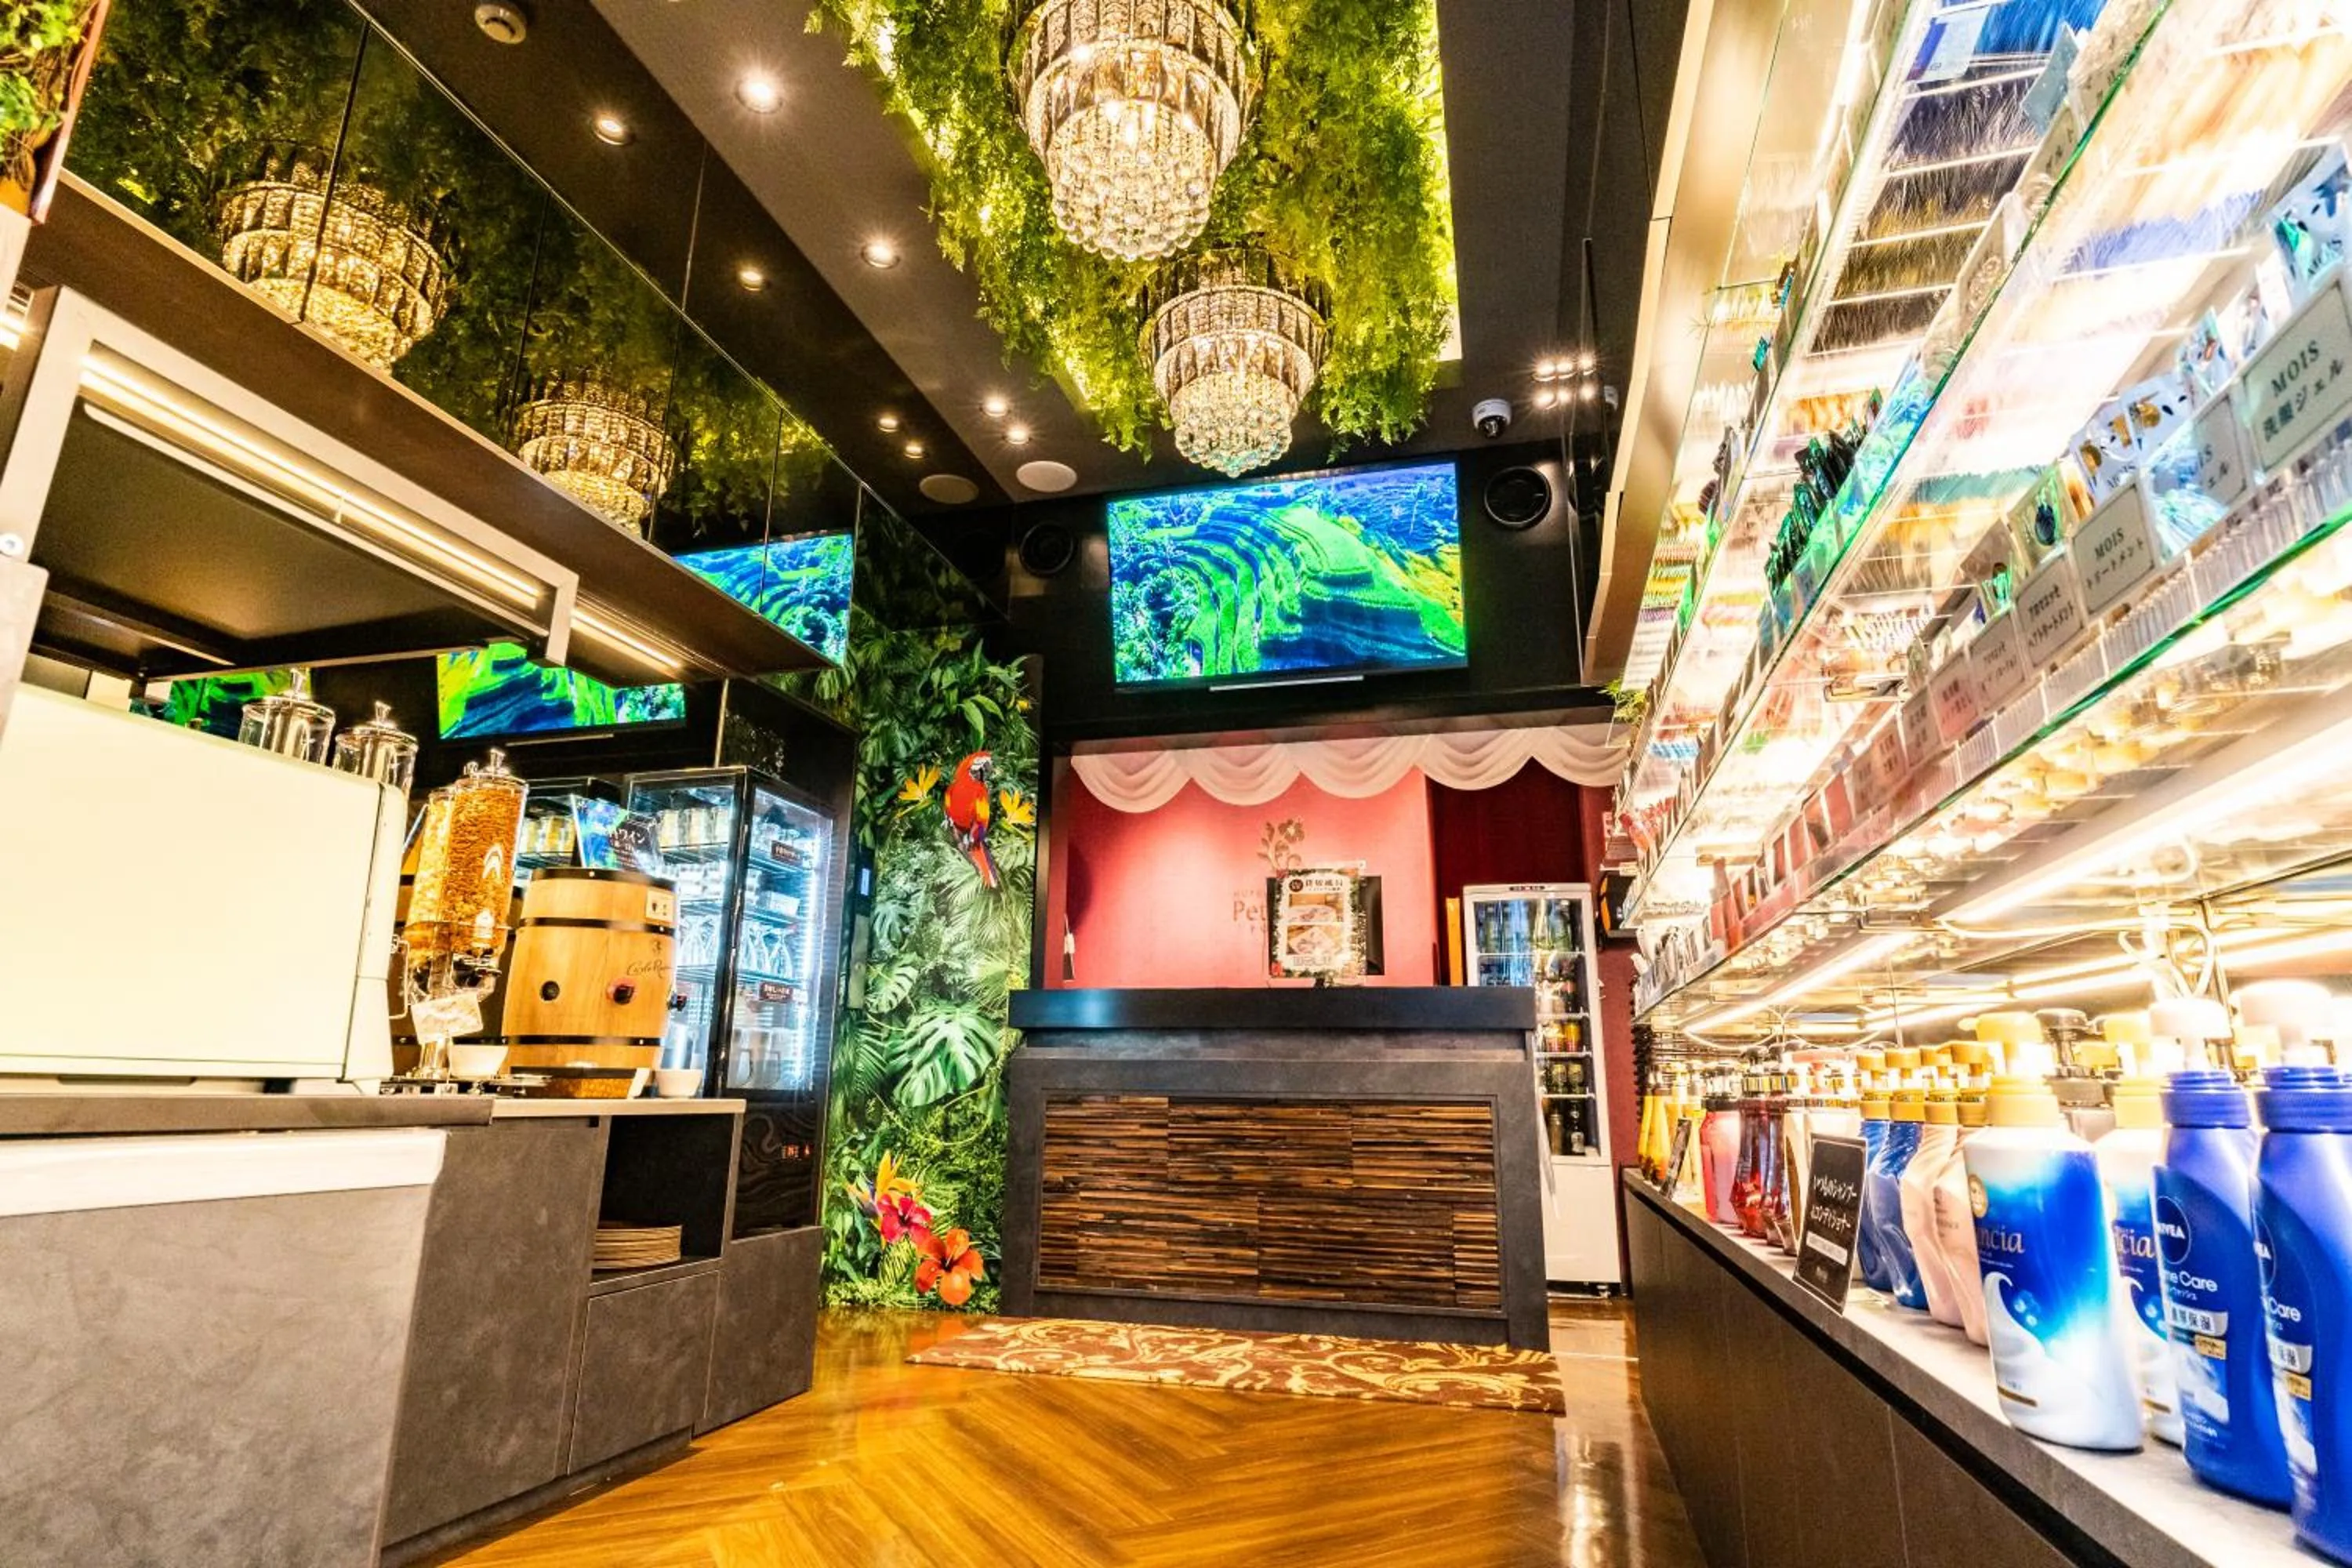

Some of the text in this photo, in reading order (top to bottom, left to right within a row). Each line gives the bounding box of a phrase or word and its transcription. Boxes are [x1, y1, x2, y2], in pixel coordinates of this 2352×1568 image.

[2270, 339, 2321, 398] MOIS
[2093, 526, 2125, 561] MOIS
[2085, 538, 2144, 590] トリートメント
[1233, 900, 1265, 922] Pet
[1977, 1224, 2026, 1254] ncia
[2179, 1270, 2219, 1293] Care
[2268, 1295, 2302, 1323] Care
